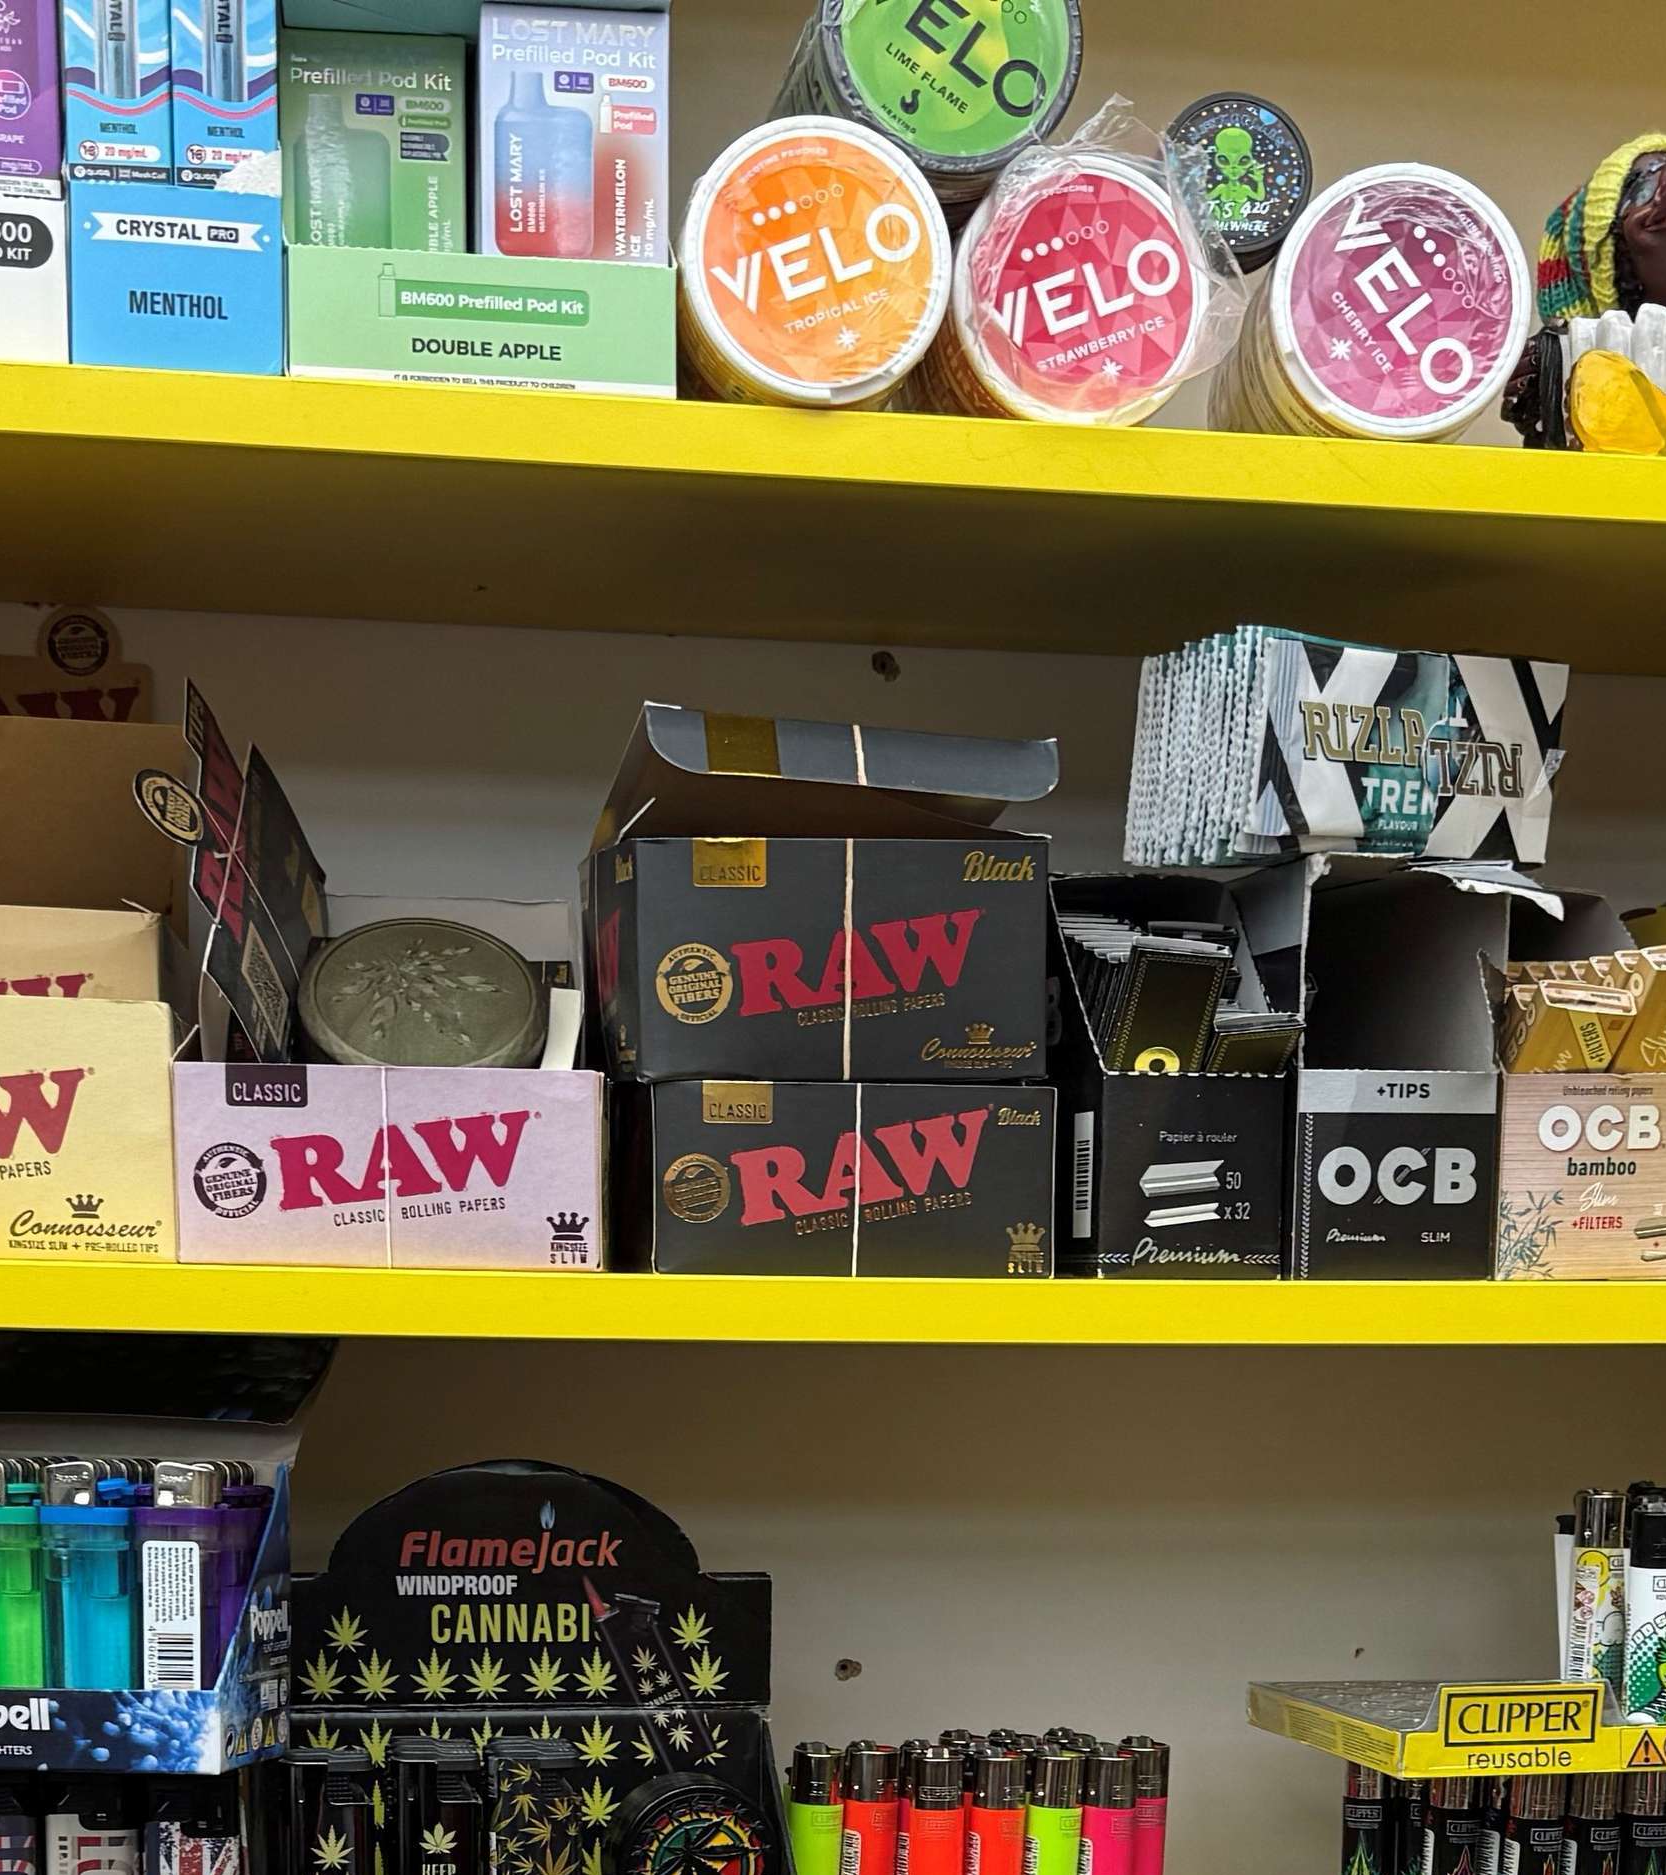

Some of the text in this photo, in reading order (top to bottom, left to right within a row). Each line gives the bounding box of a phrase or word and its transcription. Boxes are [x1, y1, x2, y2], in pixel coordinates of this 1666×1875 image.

[884, 41, 970, 114] LIME FLAME
[115, 219, 238, 243] CRYSTAL PRO
[709, 203, 920, 314] VELO
[128, 291, 228, 321] MENTHOL
[401, 292, 584, 315] BM600 Prefilled Pod Kit
[994, 238, 1182, 349] VELO
[1332, 197, 1473, 395] VELO
[783, 288, 889, 335] TROPICAL ICE
[412, 337, 561, 362] DOUBLE APPLE
[1036, 315, 1167, 373] STRAWBERRY ICE
[963, 851, 1035, 883] Black
[731, 908, 982, 1017] RAW
[232, 1083, 301, 1102] CLASSIC
[1377, 1082, 1431, 1101] +TIPS
[1538, 1105, 1662, 1152] OCB
[0, 1160, 52, 1181] PAPERS
[270, 1111, 530, 1211] RAW
[1317, 1145, 1478, 1206] OCB
[1566, 1157, 1637, 1177] bamboo
[10, 1209, 156, 1239] Connoisseur
[1571, 1217, 1623, 1230] +FILTERS
[399, 1530, 623, 1574] Flamejack
[396, 1575, 518, 1597] WINDPROOF
